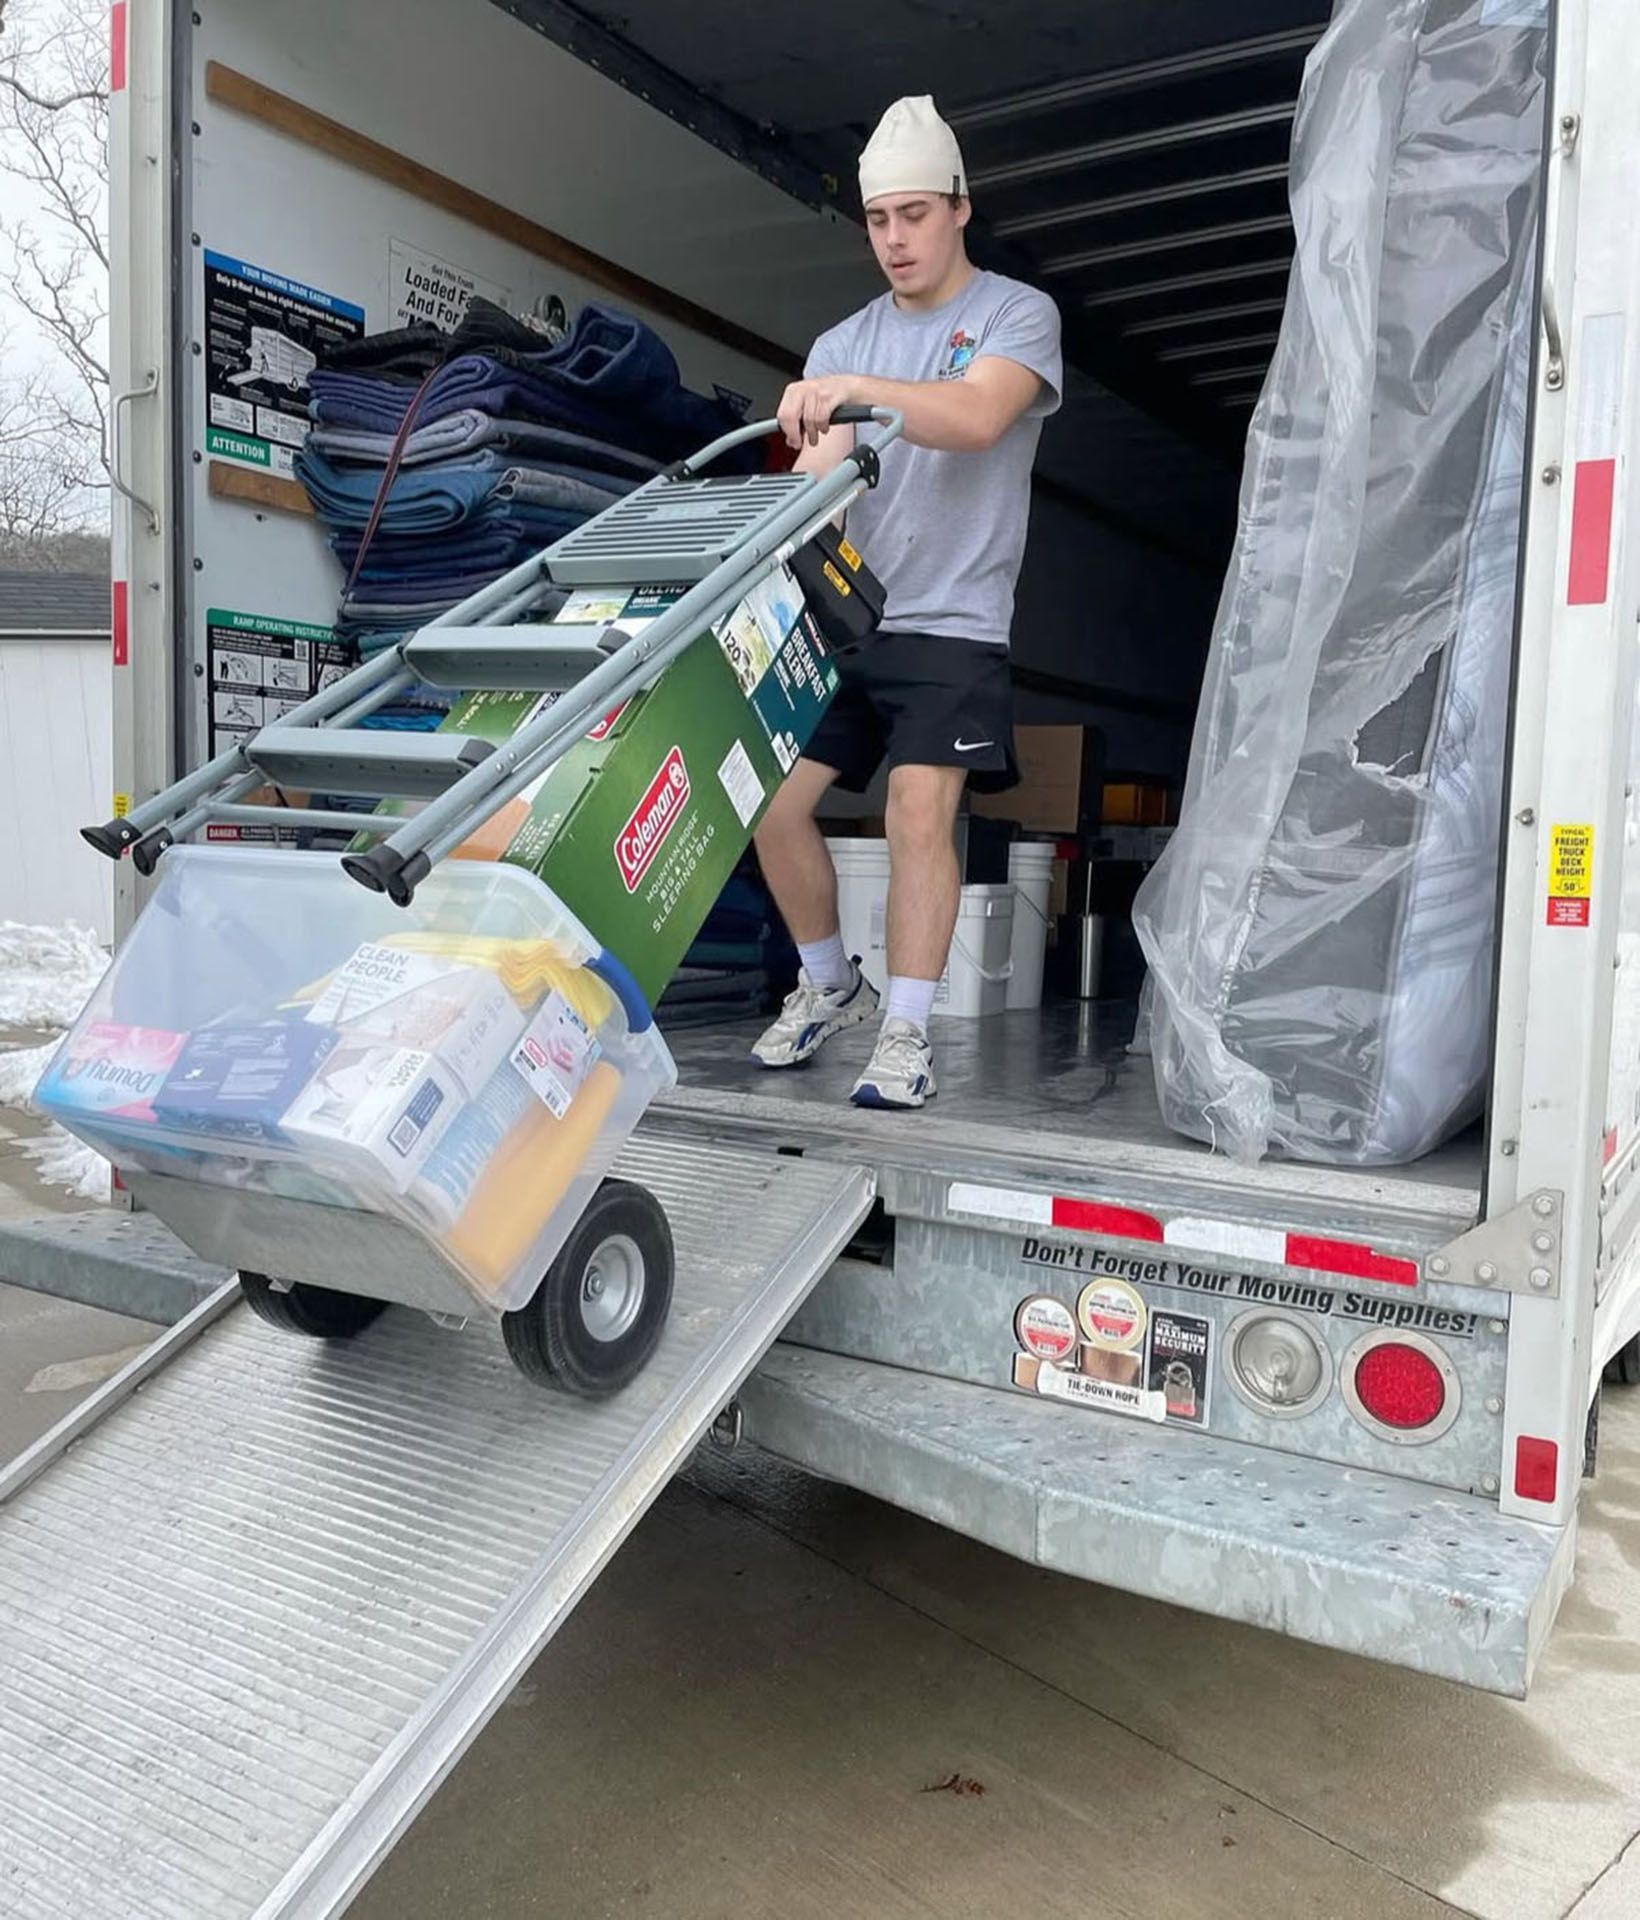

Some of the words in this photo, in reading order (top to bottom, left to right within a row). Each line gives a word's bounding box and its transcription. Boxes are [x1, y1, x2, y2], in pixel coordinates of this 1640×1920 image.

[405, 266, 456, 303] Loaded
[405, 290, 435, 316] And
[436, 302, 460, 326] For
[212, 436, 265, 460] ATTENTION
[233, 615, 255, 627] RAMP
[255, 619, 293, 635] OPERATING
[723, 630, 742, 662] 120
[782, 641, 807, 689] BLEND
[791, 626, 826, 703] BREAKFAST
[621, 783, 675, 872] Coleman
[1555, 837, 1589, 847] FREIGHT
[660, 876, 677, 900] BIG
[680, 835, 700, 864] TALL
[1559, 847, 1585, 857] TRUCK
[1560, 858, 1582, 867] DECK
[645, 848, 681, 904] MOUNTAIN
[652, 859, 697, 934] SLEEPING
[695, 823, 715, 858] BAG
[1556, 868, 1585, 877] HEIGHT
[358, 945, 410, 967] CLEAN
[87, 1057, 154, 1093] Downy
[1022, 1238, 1084, 1267] Don't
[1091, 1250, 1168, 1281] Forget
[1176, 1263, 1231, 1292] Your
[1238, 1274, 1335, 1314] Moving
[1342, 1293, 1478, 1333] Supplies!
[1155, 1336, 1206, 1356] SECURITY
[1156, 1326, 1206, 1343] MAXIMUM
[1067, 1378, 1113, 1399] TIE-DOWN
[1114, 1390, 1140, 1406] ROPE
